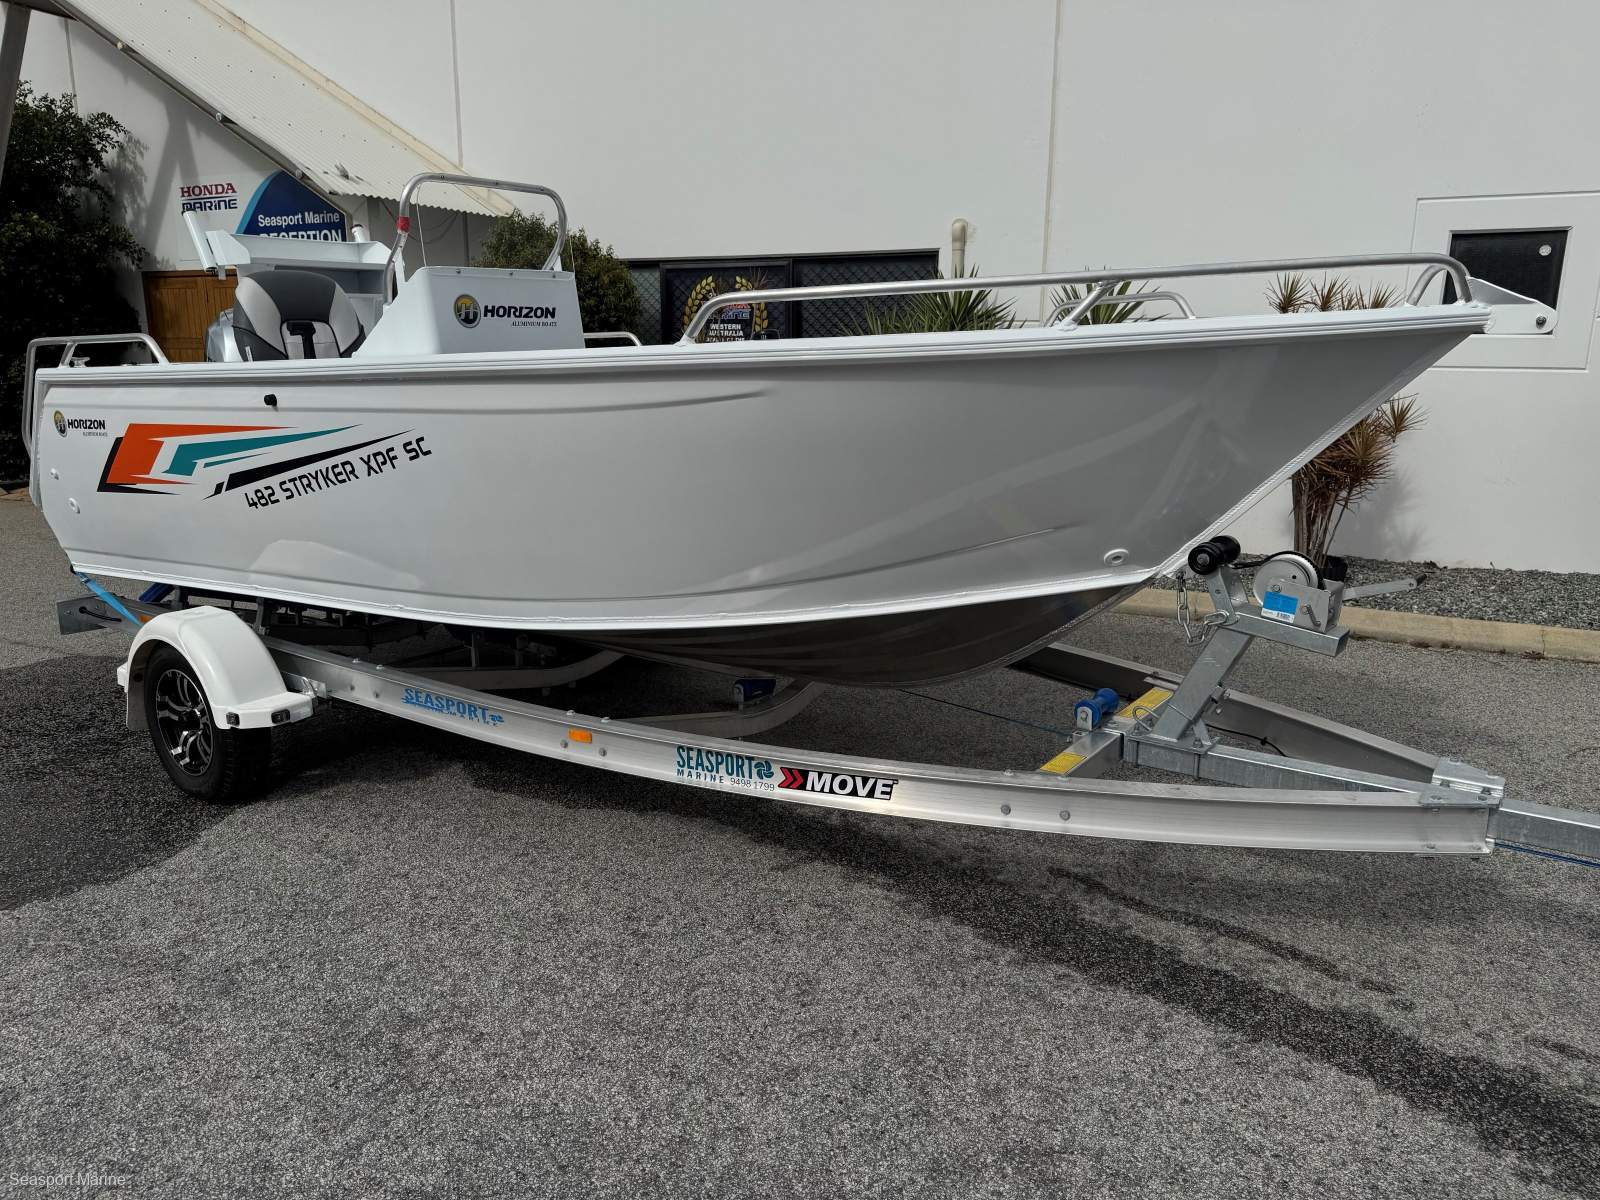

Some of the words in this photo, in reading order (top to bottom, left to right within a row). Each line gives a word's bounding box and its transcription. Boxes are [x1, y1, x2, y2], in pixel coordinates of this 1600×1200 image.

[180, 183, 237, 198] HONDA
[182, 199, 238, 212] MARINE
[258, 213, 303, 228] Seasport
[305, 211, 340, 224] Marine
[259, 229, 342, 242] PTION
[483, 305, 556, 319] HORIZON
[67, 419, 106, 430] HORIZON
[245, 485, 281, 510] 482
[279, 459, 360, 500] STRYKER
[359, 447, 398, 477] XPF
[403, 436, 433, 461] SC
[402, 687, 489, 722] SEASPORT
[676, 746, 755, 779] SEASPORT
[806, 771, 894, 800] MOVE
[677, 769, 724, 784] MARINE
[730, 777, 752, 787] 9498
[754, 780, 775, 792] 1799
